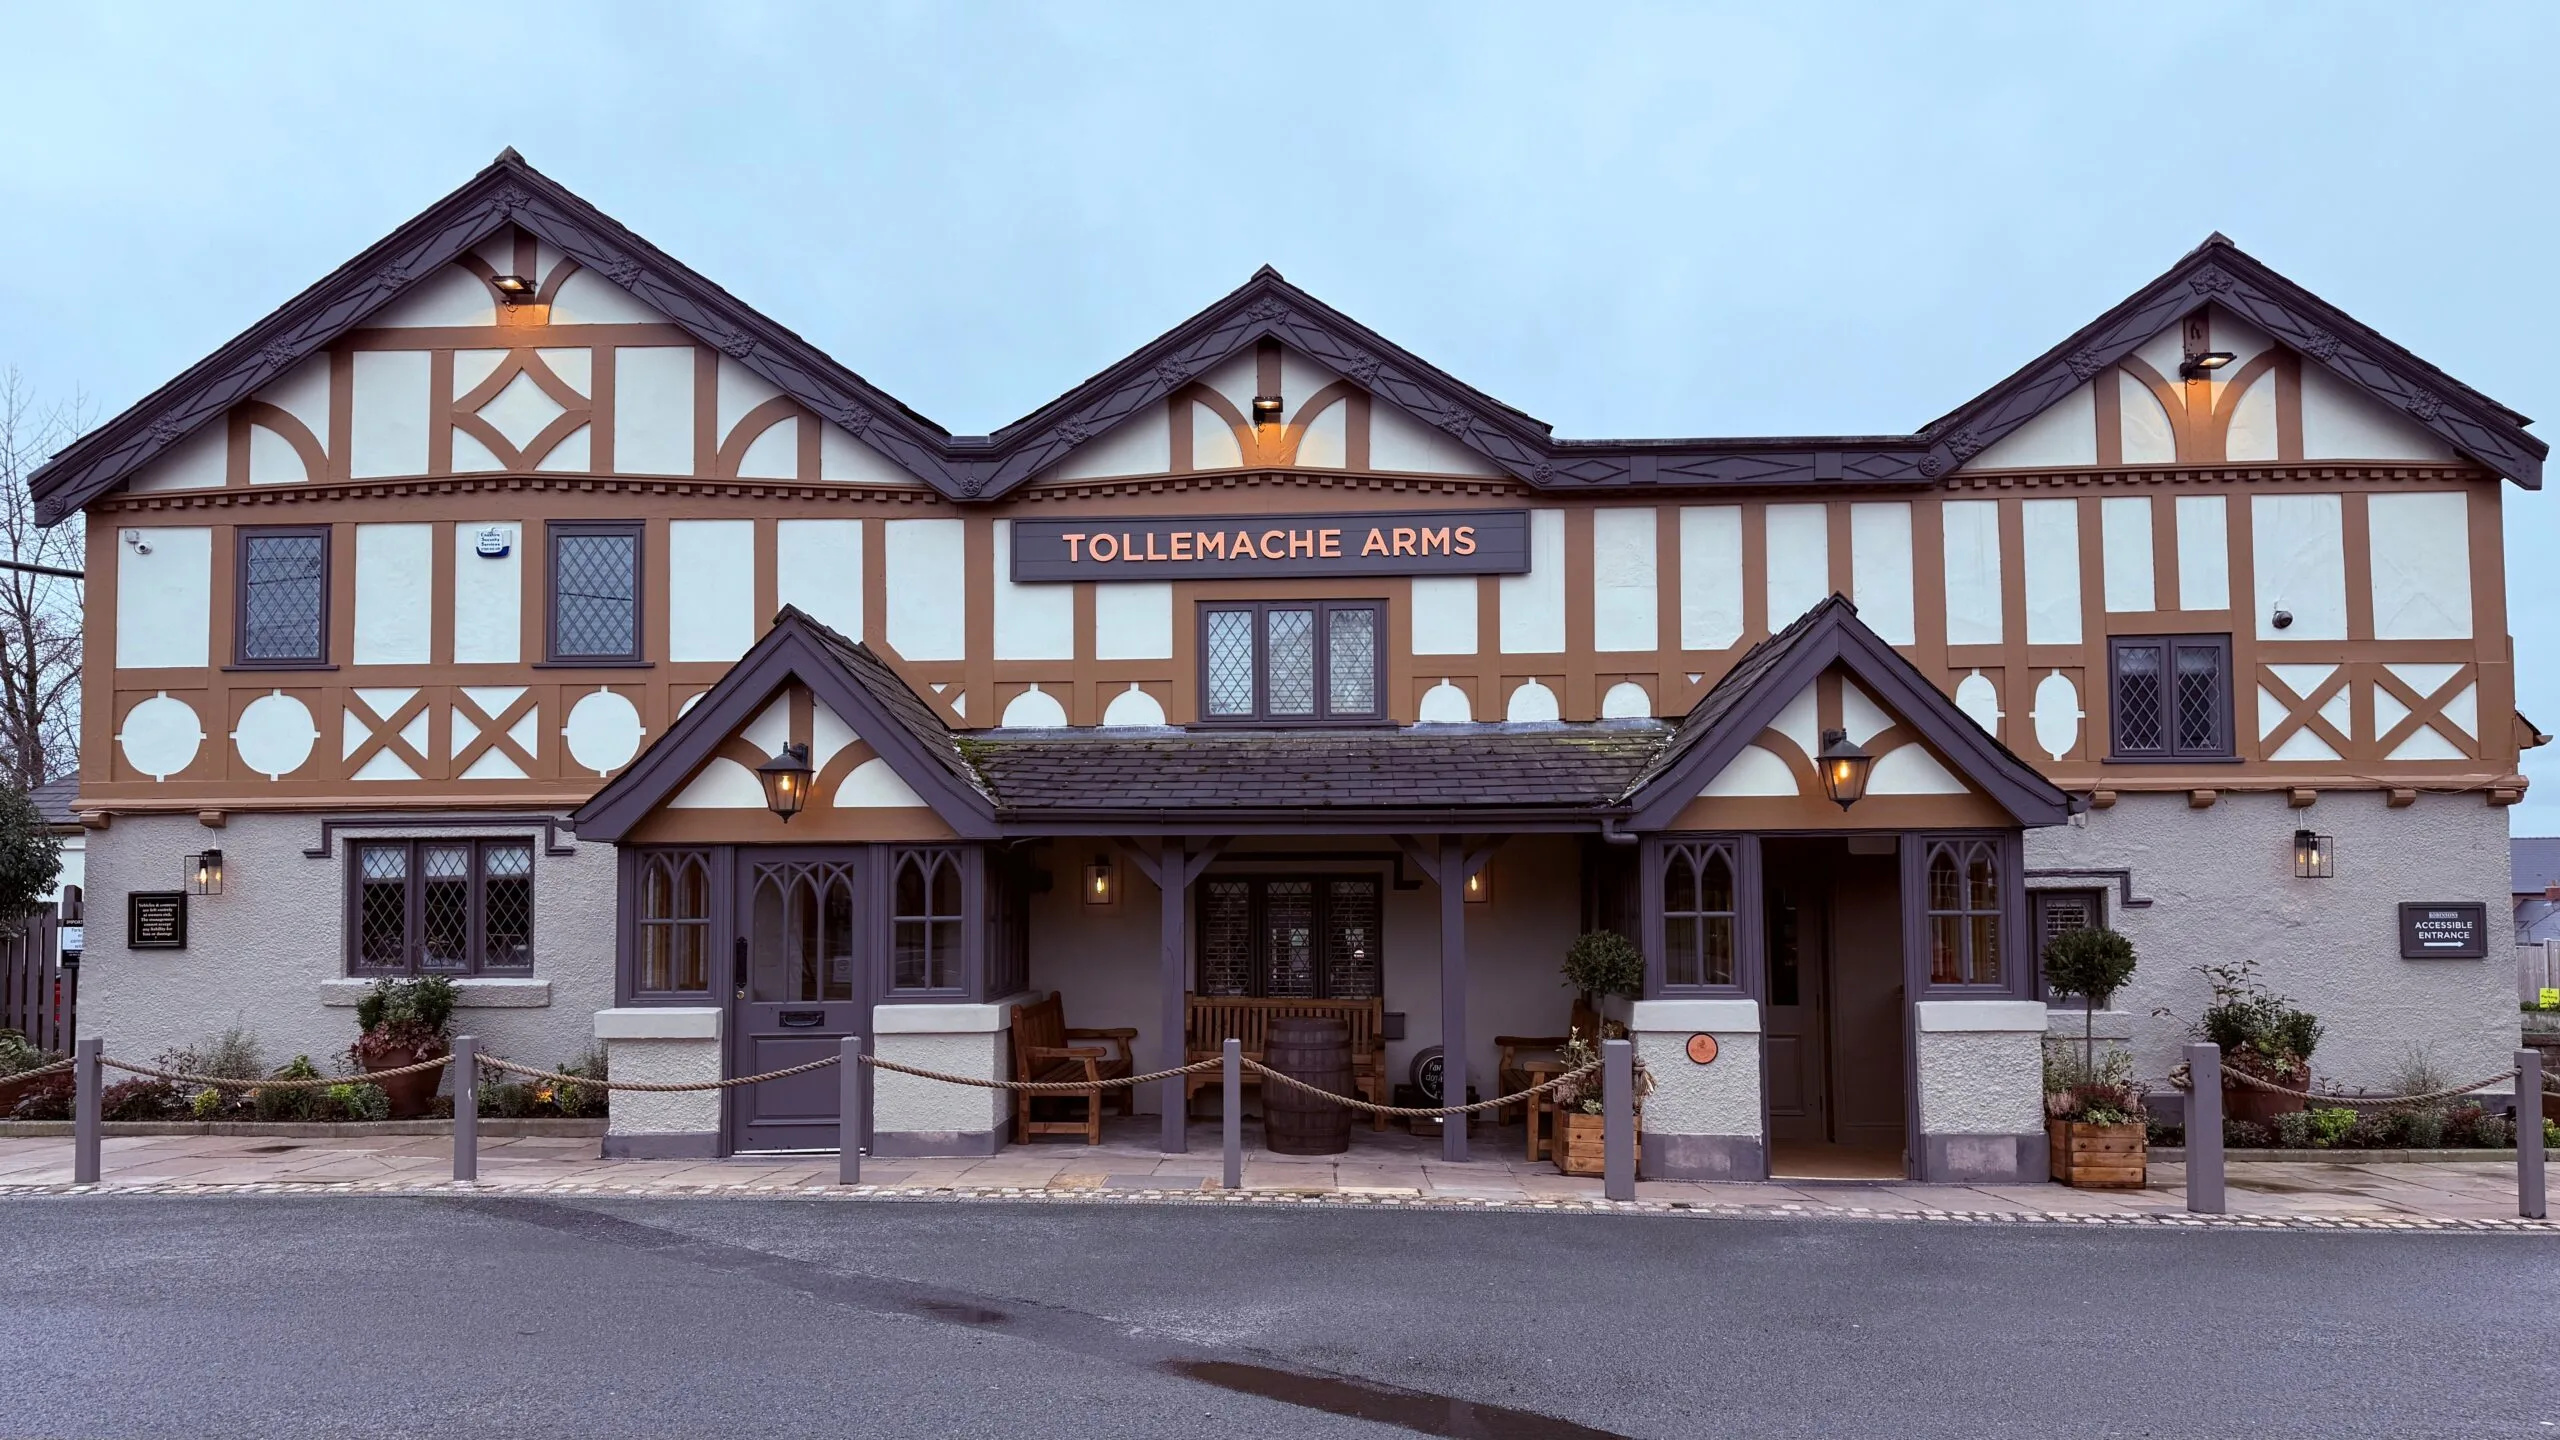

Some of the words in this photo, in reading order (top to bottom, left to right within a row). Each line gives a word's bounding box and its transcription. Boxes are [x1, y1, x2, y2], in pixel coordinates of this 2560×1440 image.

[1062, 529, 1342, 562] TOLLEMACHE
[1360, 526, 1477, 558] ARMS
[2415, 921, 2473, 929] ACCESSIBLE
[2418, 931, 2470, 939] ENTRANCE
